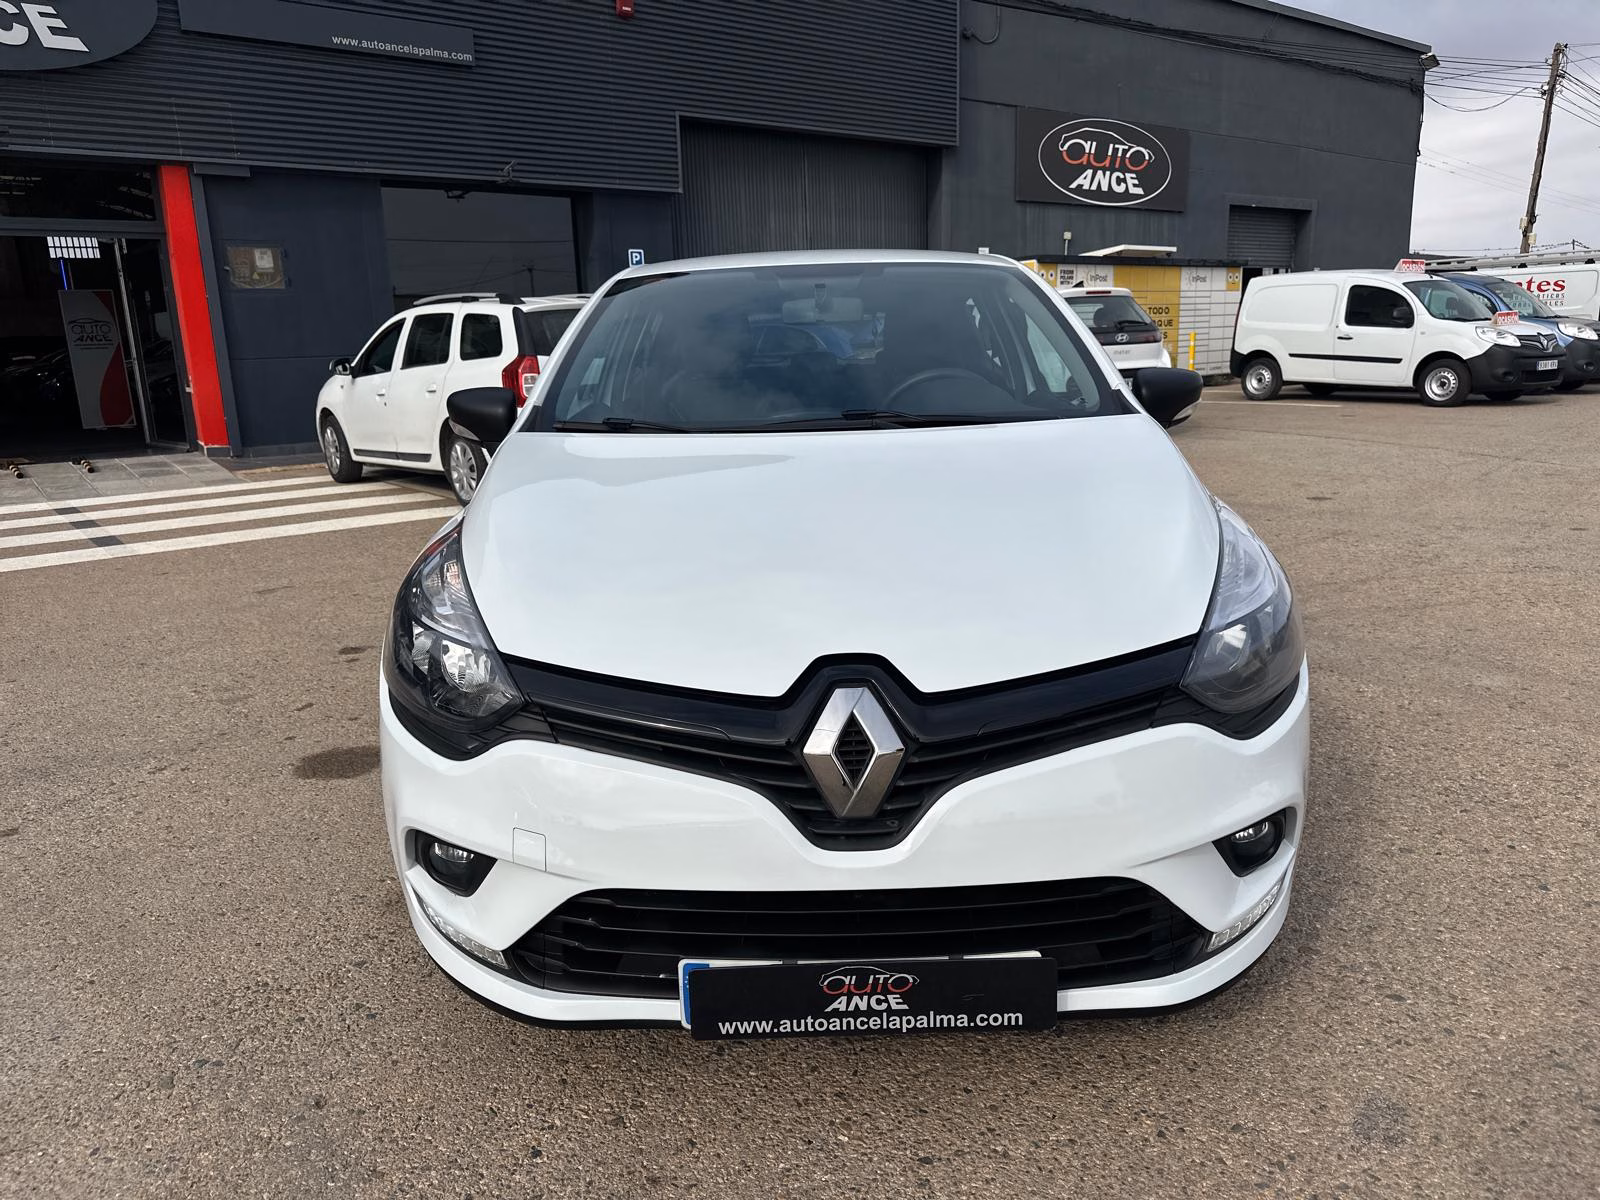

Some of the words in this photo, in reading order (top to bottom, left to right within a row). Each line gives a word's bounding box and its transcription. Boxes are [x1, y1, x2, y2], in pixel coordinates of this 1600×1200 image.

[331, 35, 473, 62] www.autoancelapalma.com
[1068, 168, 1145, 195] ANCE
[632, 252, 641, 264] P
[1089, 273, 1108, 282] InPost
[1148, 306, 1170, 315] TODO
[824, 994, 910, 1012] ANCE
[717, 1010, 1024, 1035] www.autoancelapalma.com
